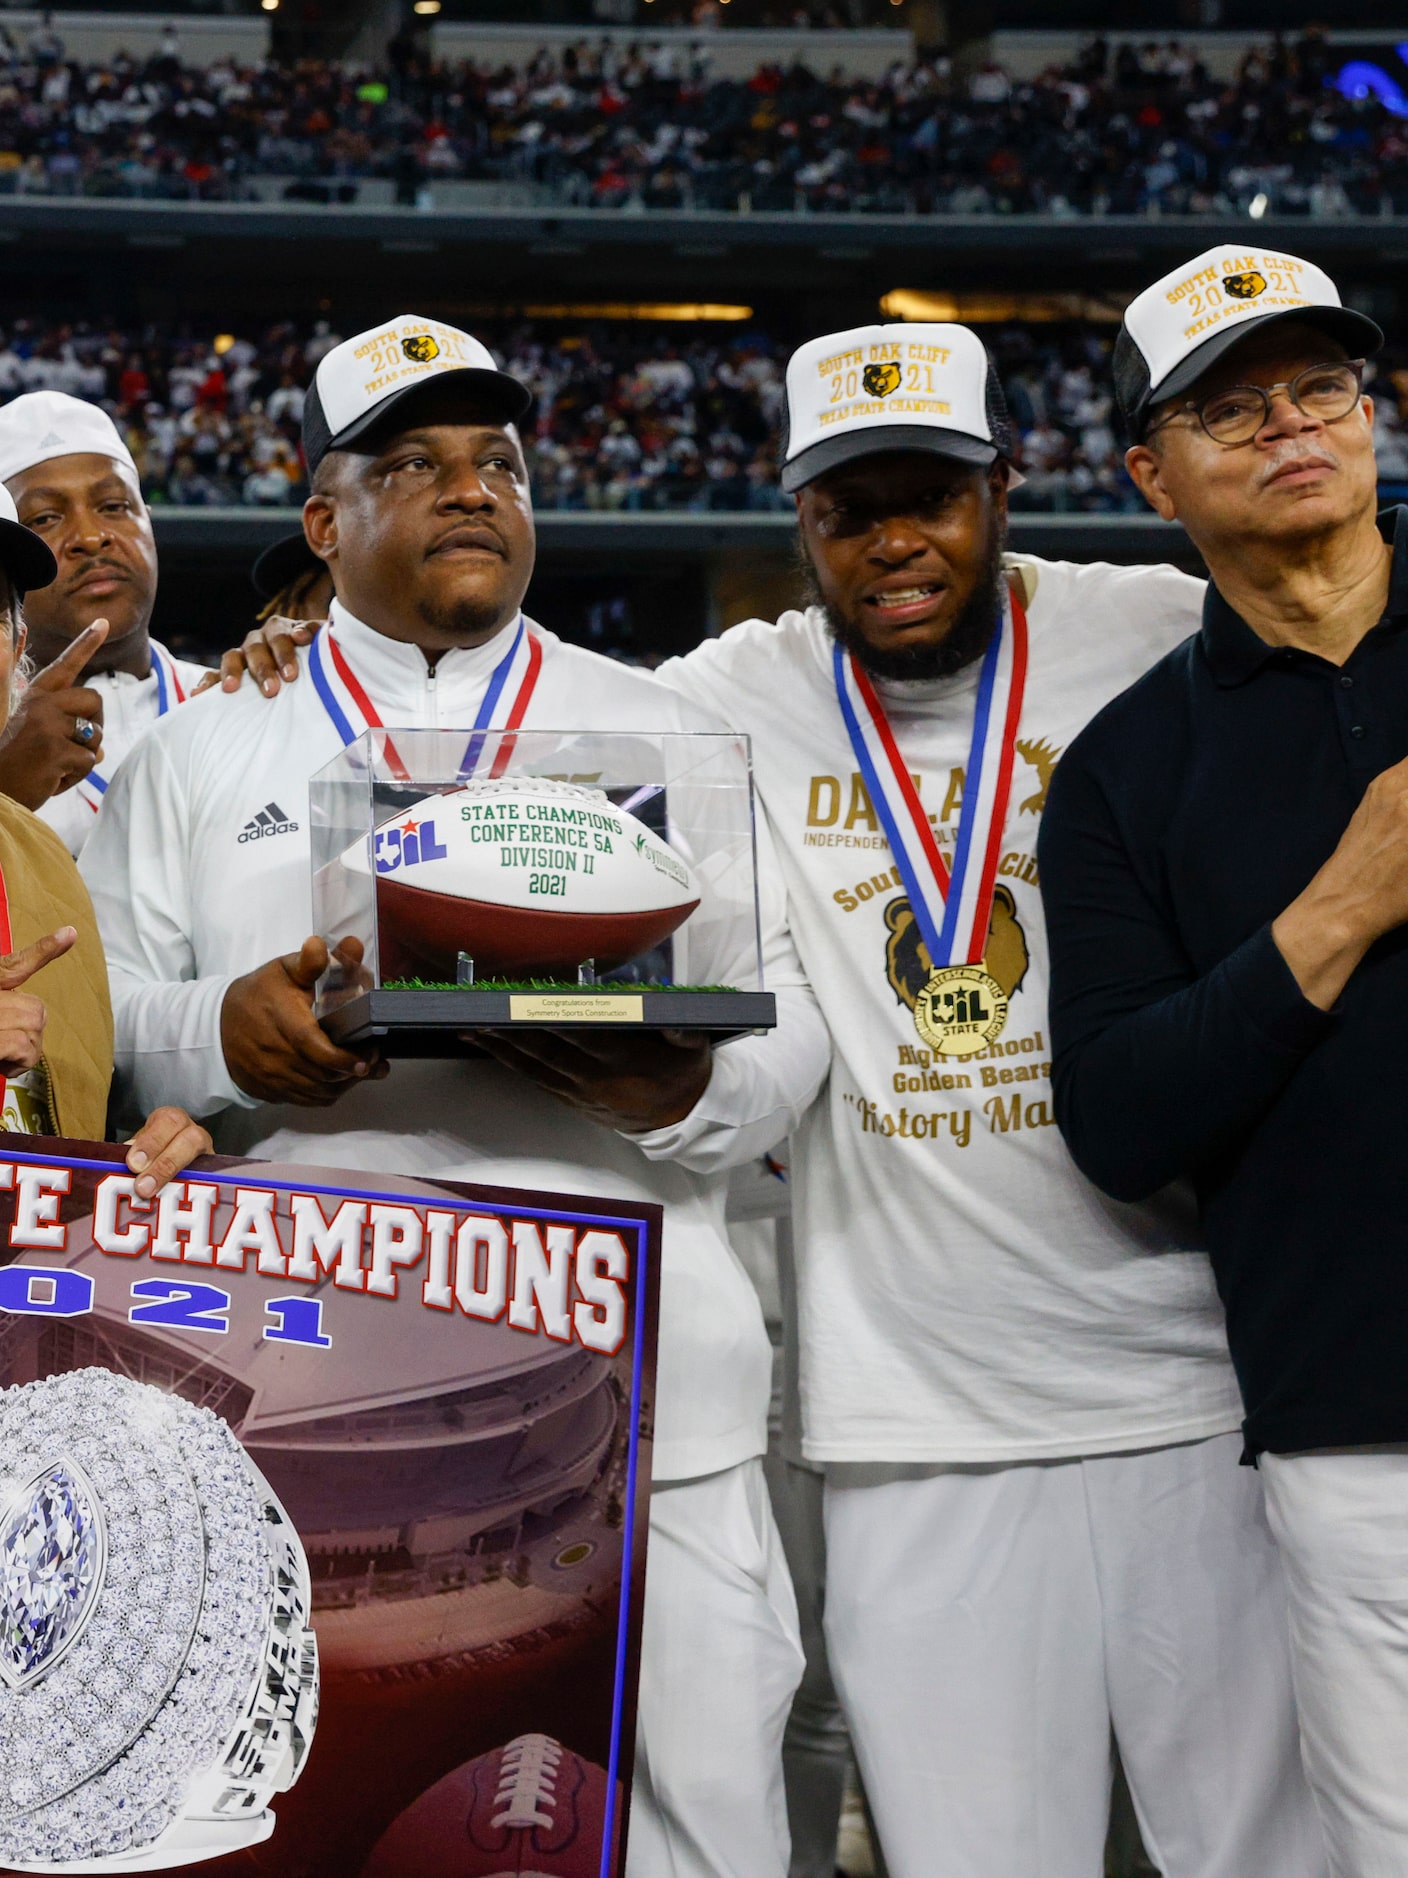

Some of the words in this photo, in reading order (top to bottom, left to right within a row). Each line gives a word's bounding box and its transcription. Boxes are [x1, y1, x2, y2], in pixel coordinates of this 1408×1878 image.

[1165, 265, 1219, 305] SOUTH
[1222, 256, 1258, 274] OAK
[1263, 257, 1304, 273] CLIFF
[1189, 285, 1222, 317] 20
[1269, 271, 1302, 294] 21
[1184, 312, 1222, 340] TEXAS
[1223, 300, 1259, 316] STATE
[354, 330, 398, 359] SOUTH
[402, 324, 431, 335] OAK
[371, 345, 401, 373] 20
[440, 338, 468, 361] 21
[817, 347, 863, 378] SOUTH
[869, 343, 902, 361] OAK
[908, 343, 951, 364] CLIFF
[830, 370, 857, 403] 20
[906, 363, 935, 393] 21
[819, 407, 849, 427] TEXAS
[852, 401, 885, 416] STATE
[237, 822, 299, 843] adidas
[461, 804, 519, 821] STATE
[526, 804, 623, 835] CHAMPIONS
[374, 820, 447, 873] UIL
[471, 824, 588, 849] CONFERENCE
[593, 833, 613, 854] 5A
[500, 847, 577, 872] DIVISION
[583, 853, 595, 875] II
[529, 873, 566, 896] 2021
[527, 1009, 560, 1017] Symmetry
[561, 1009, 584, 1017] Sports
[585, 1009, 627, 1017] Construction
[542, 999, 594, 1007] Congratulations
[931, 990, 989, 1024] UIL
[943, 1023, 979, 1036] STATE
[893, 1070, 972, 1093] Golden
[92, 1172, 630, 1355] CHAMPIONS
